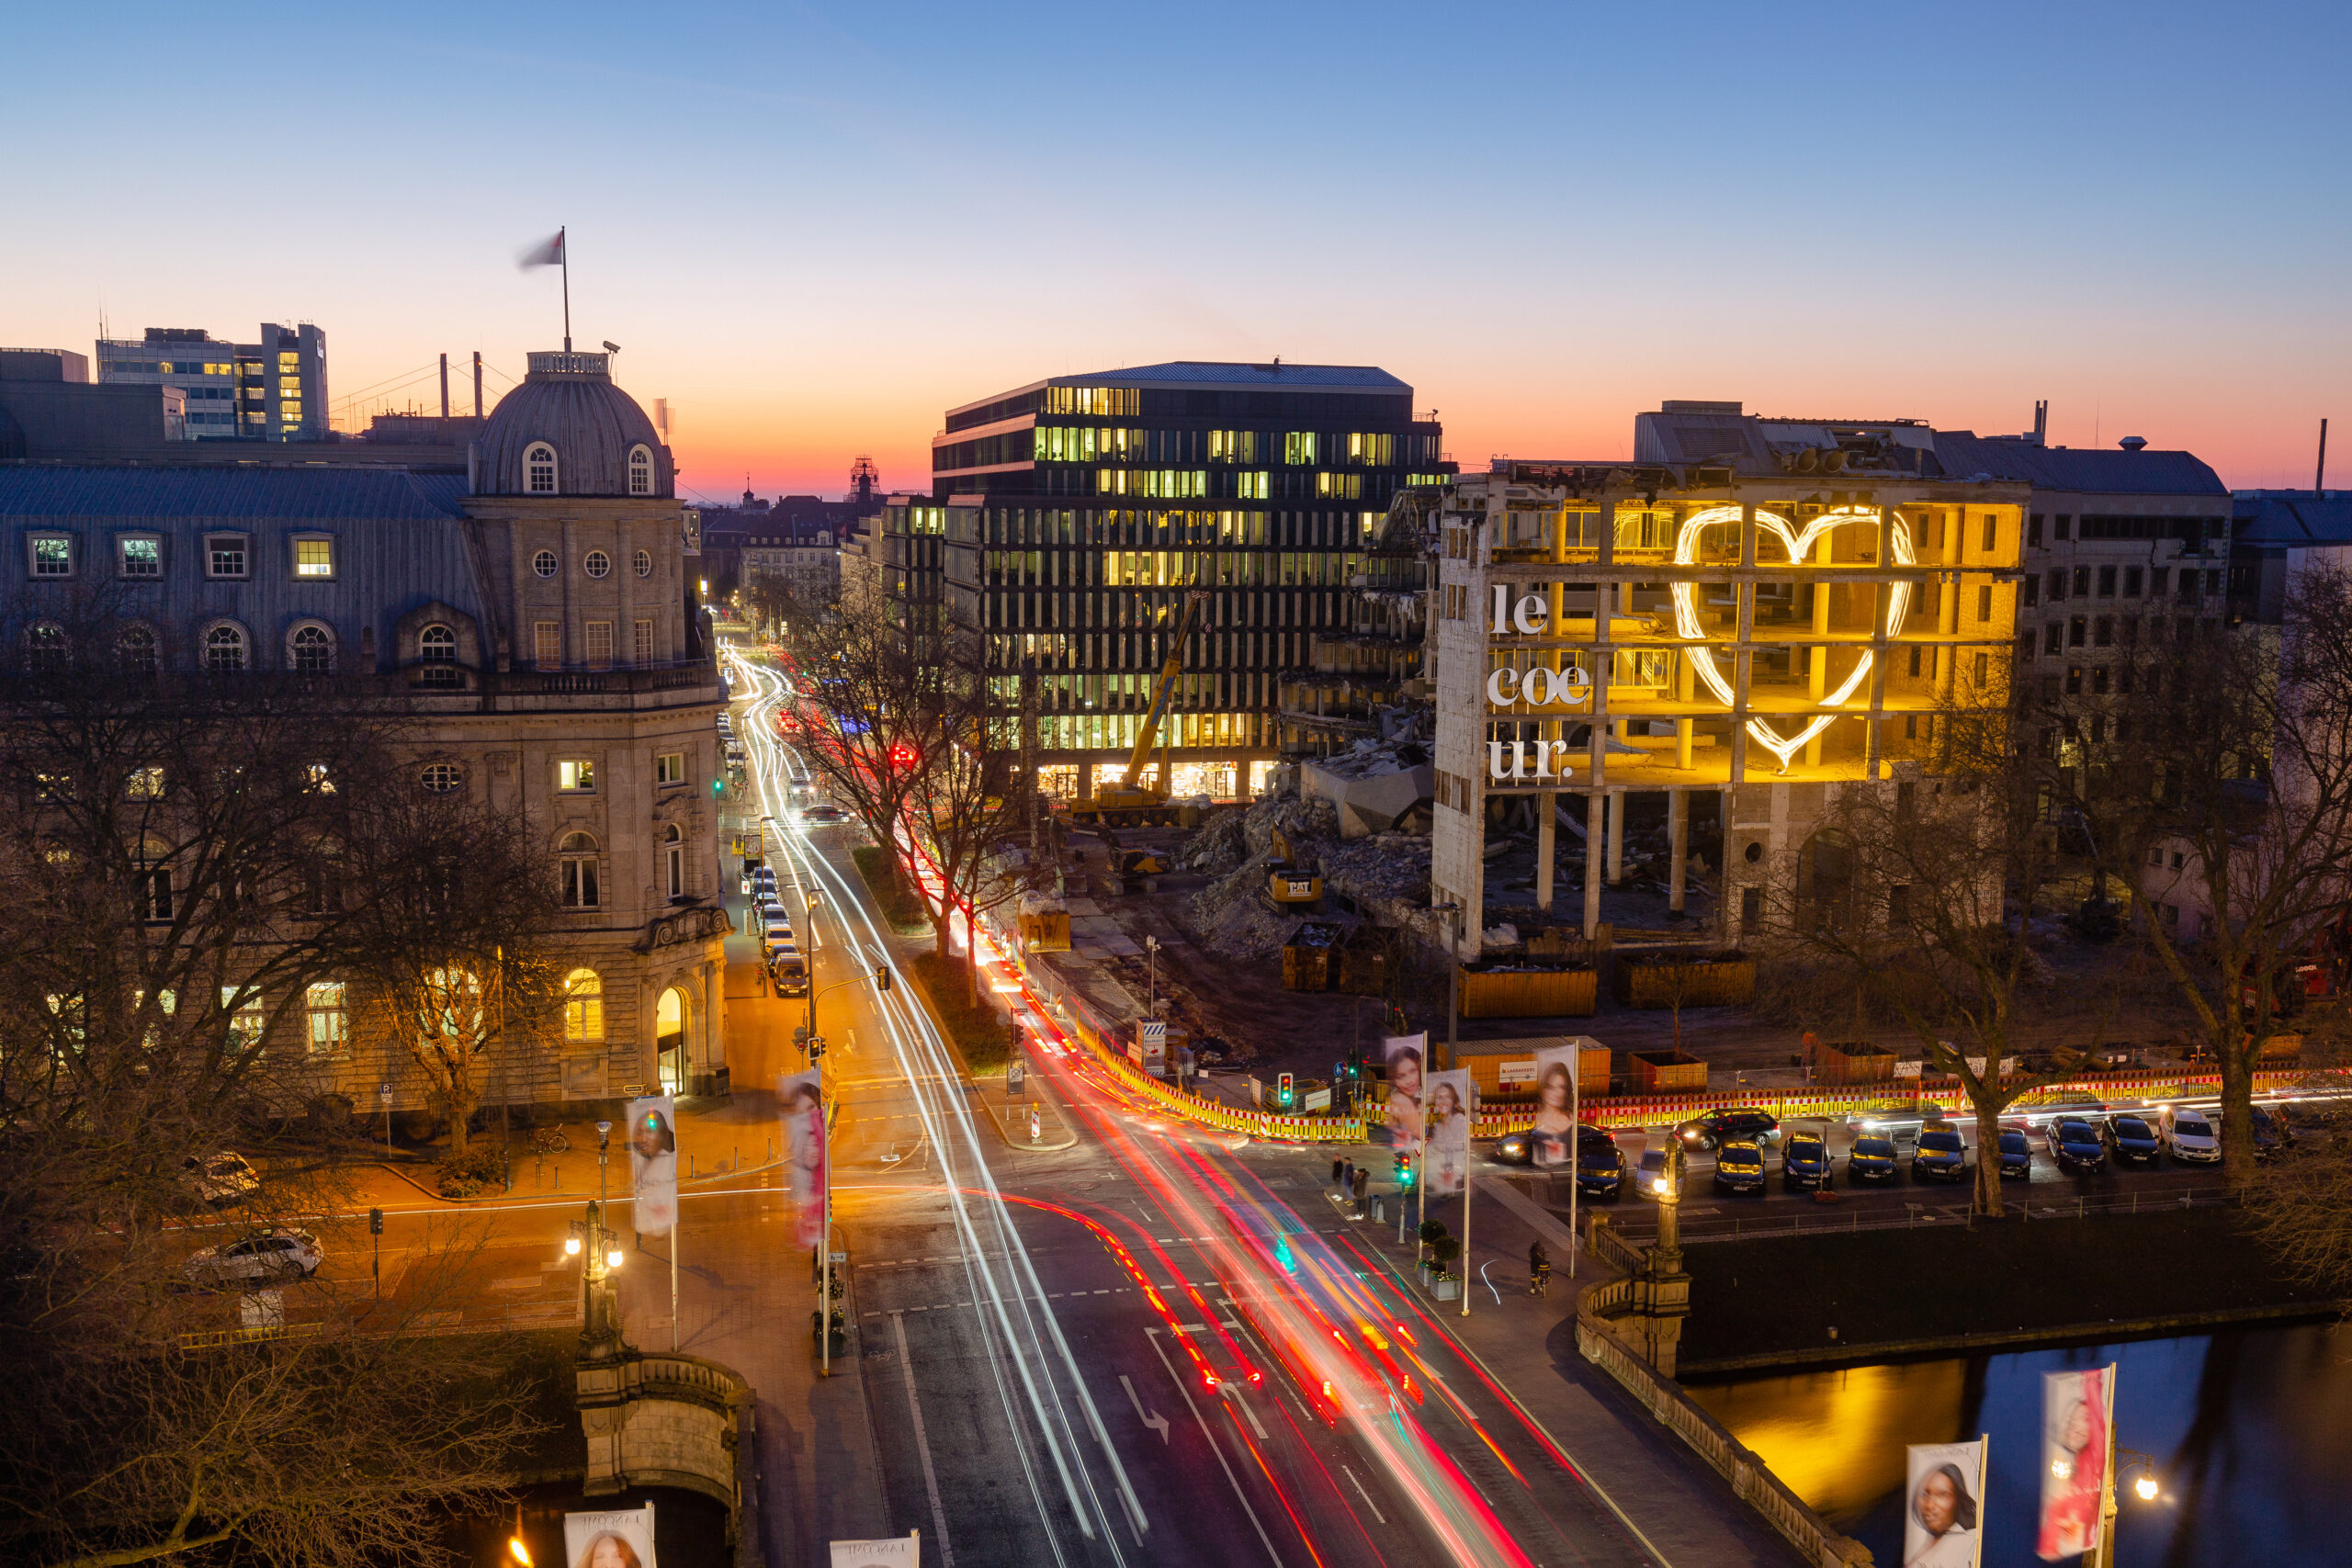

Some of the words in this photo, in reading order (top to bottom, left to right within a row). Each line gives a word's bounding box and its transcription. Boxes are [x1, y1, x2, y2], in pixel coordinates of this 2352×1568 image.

[1490, 584, 1547, 635] le
[1487, 667, 1589, 706] coe
[1487, 739, 1573, 779] ur.
[1288, 882, 1310, 893] CAT
